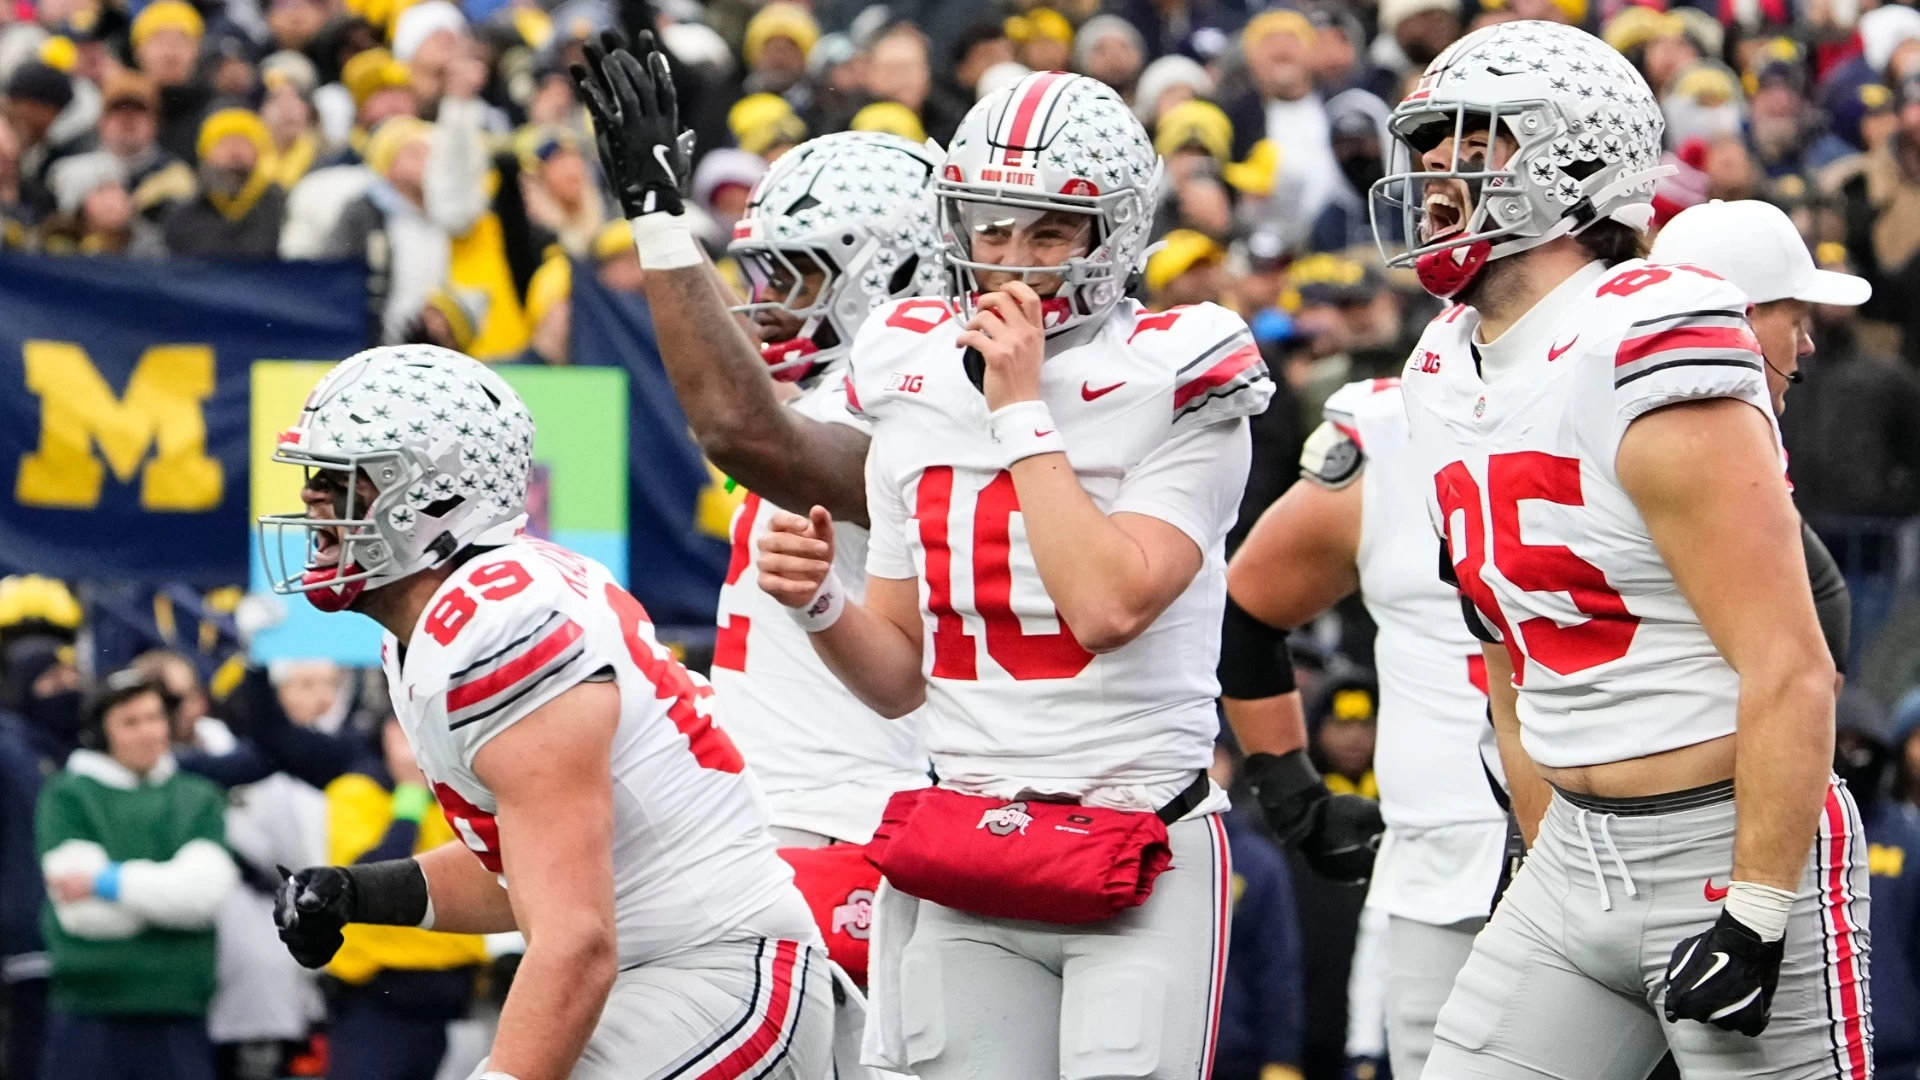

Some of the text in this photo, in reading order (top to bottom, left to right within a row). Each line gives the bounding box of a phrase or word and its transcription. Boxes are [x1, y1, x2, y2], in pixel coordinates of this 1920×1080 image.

[1006, 172, 1035, 185] STATE
[15, 338, 224, 512] M
[424, 560, 534, 647] 89
[913, 465, 1096, 681] 10
